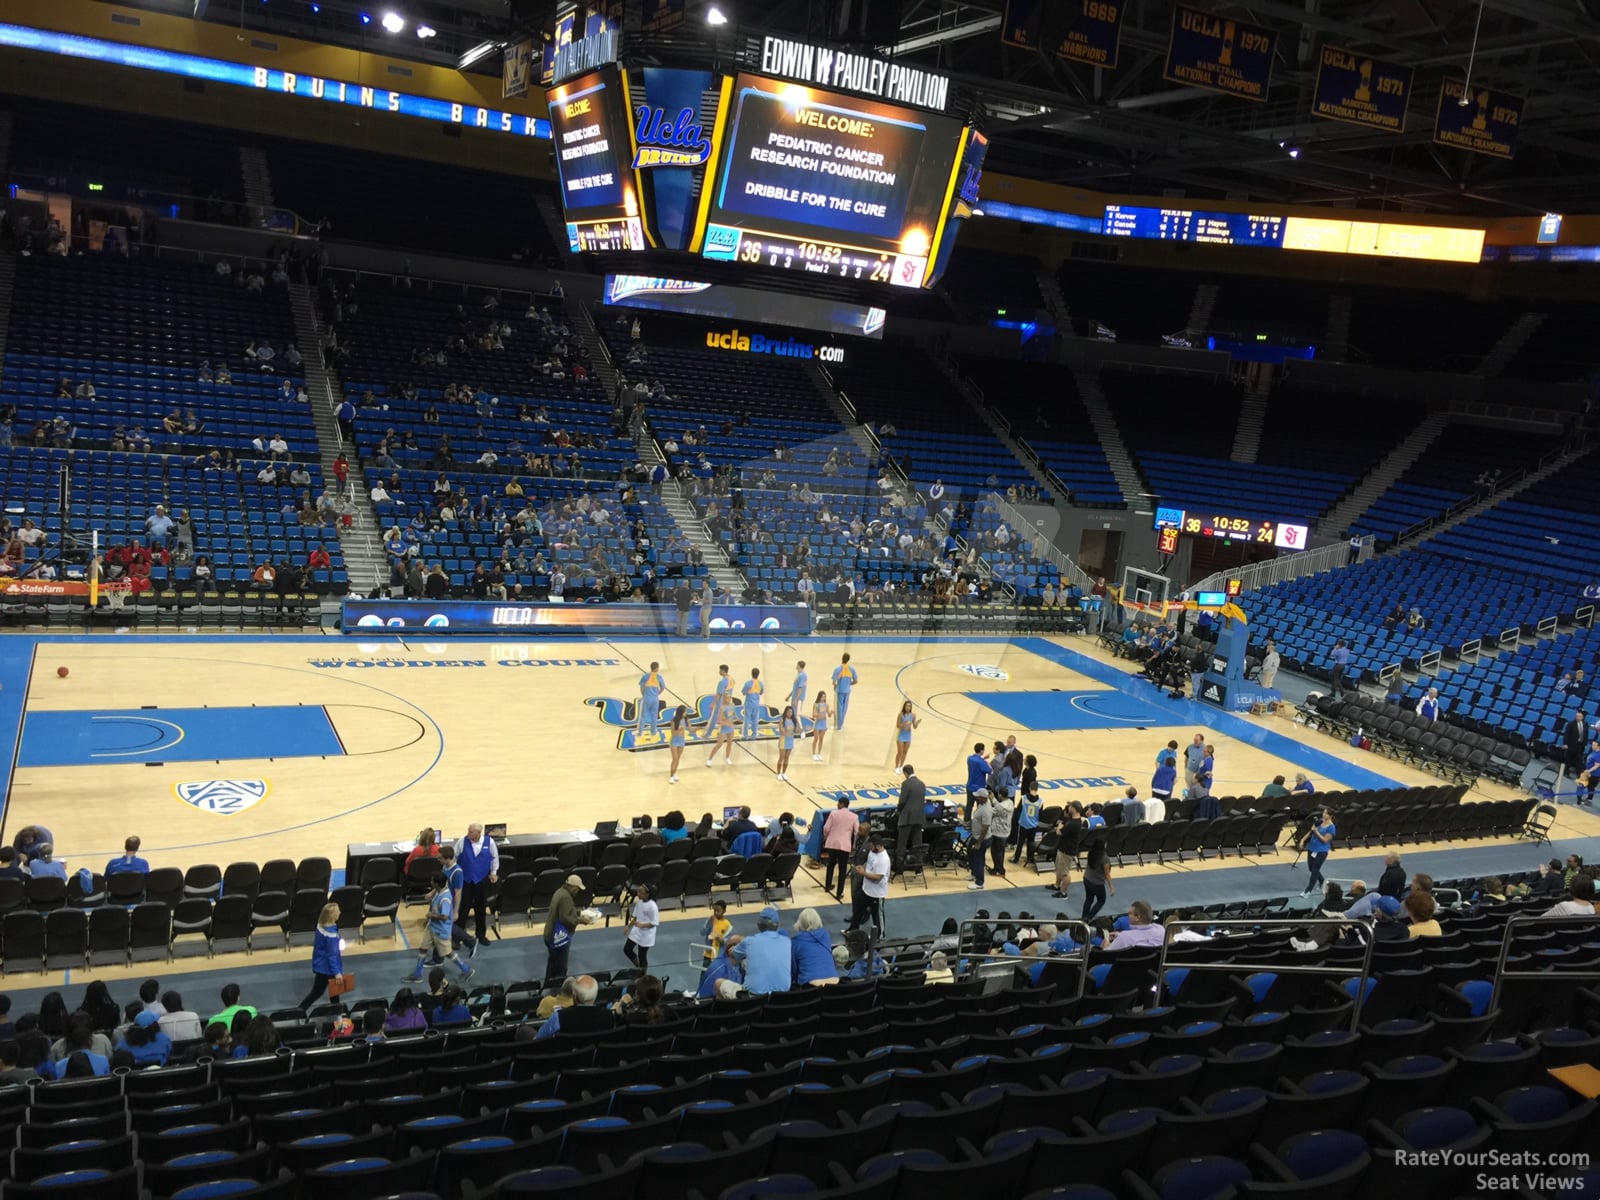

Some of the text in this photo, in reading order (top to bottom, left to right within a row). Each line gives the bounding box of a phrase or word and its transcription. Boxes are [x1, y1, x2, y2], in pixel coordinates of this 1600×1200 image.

[1181, 10, 1221, 40] UCLA
[1240, 31, 1270, 52] 1970
[1196, 60, 1244, 80] BASKETBALL
[1324, 49, 1356, 72] UCLA
[762, 36, 814, 81] EDWIN
[834, 51, 888, 96] PAULEY
[888, 64, 949, 111] PAVILION
[1174, 64, 1262, 95] NATIONAL CHAMPIONS
[1376, 76, 1404, 97] 1971
[254, 66, 553, 139] BRUINS BASK
[1318, 102, 1400, 128] NATIONAL CHAMPIONS
[794, 109, 875, 138] WELCOME:
[1492, 105, 1518, 126] 1972
[768, 132, 884, 166] PEDIATRIC CANCER
[1440, 130, 1510, 154] NATIONAL CHAMPIONS
[637, 149, 702, 166] BRUINS
[750, 147, 896, 186] RESEARCH FOUNDATION
[745, 182, 887, 218] DRIBBLE FOR THE CURE
[741, 240, 762, 263] 36
[798, 243, 842, 264] 10:52
[870, 260, 891, 282] 24
[770, 254, 777, 266] 0
[784, 256, 792, 268] 3
[840, 264, 848, 277] 3
[854, 267, 862, 279] 3
[706, 329, 844, 363] uclaBruins.com
[1186, 518, 1201, 533] 36
[1212, 516, 1250, 532] 10:52
[1256, 528, 1273, 543] 24
[1162, 536, 1174, 551] 30
[492, 608, 532, 625] UCLA
[310, 659, 620, 669] WOODEN COURT
[1037, 776, 1132, 790] OURT
[1028, 805, 1035, 816] 0
